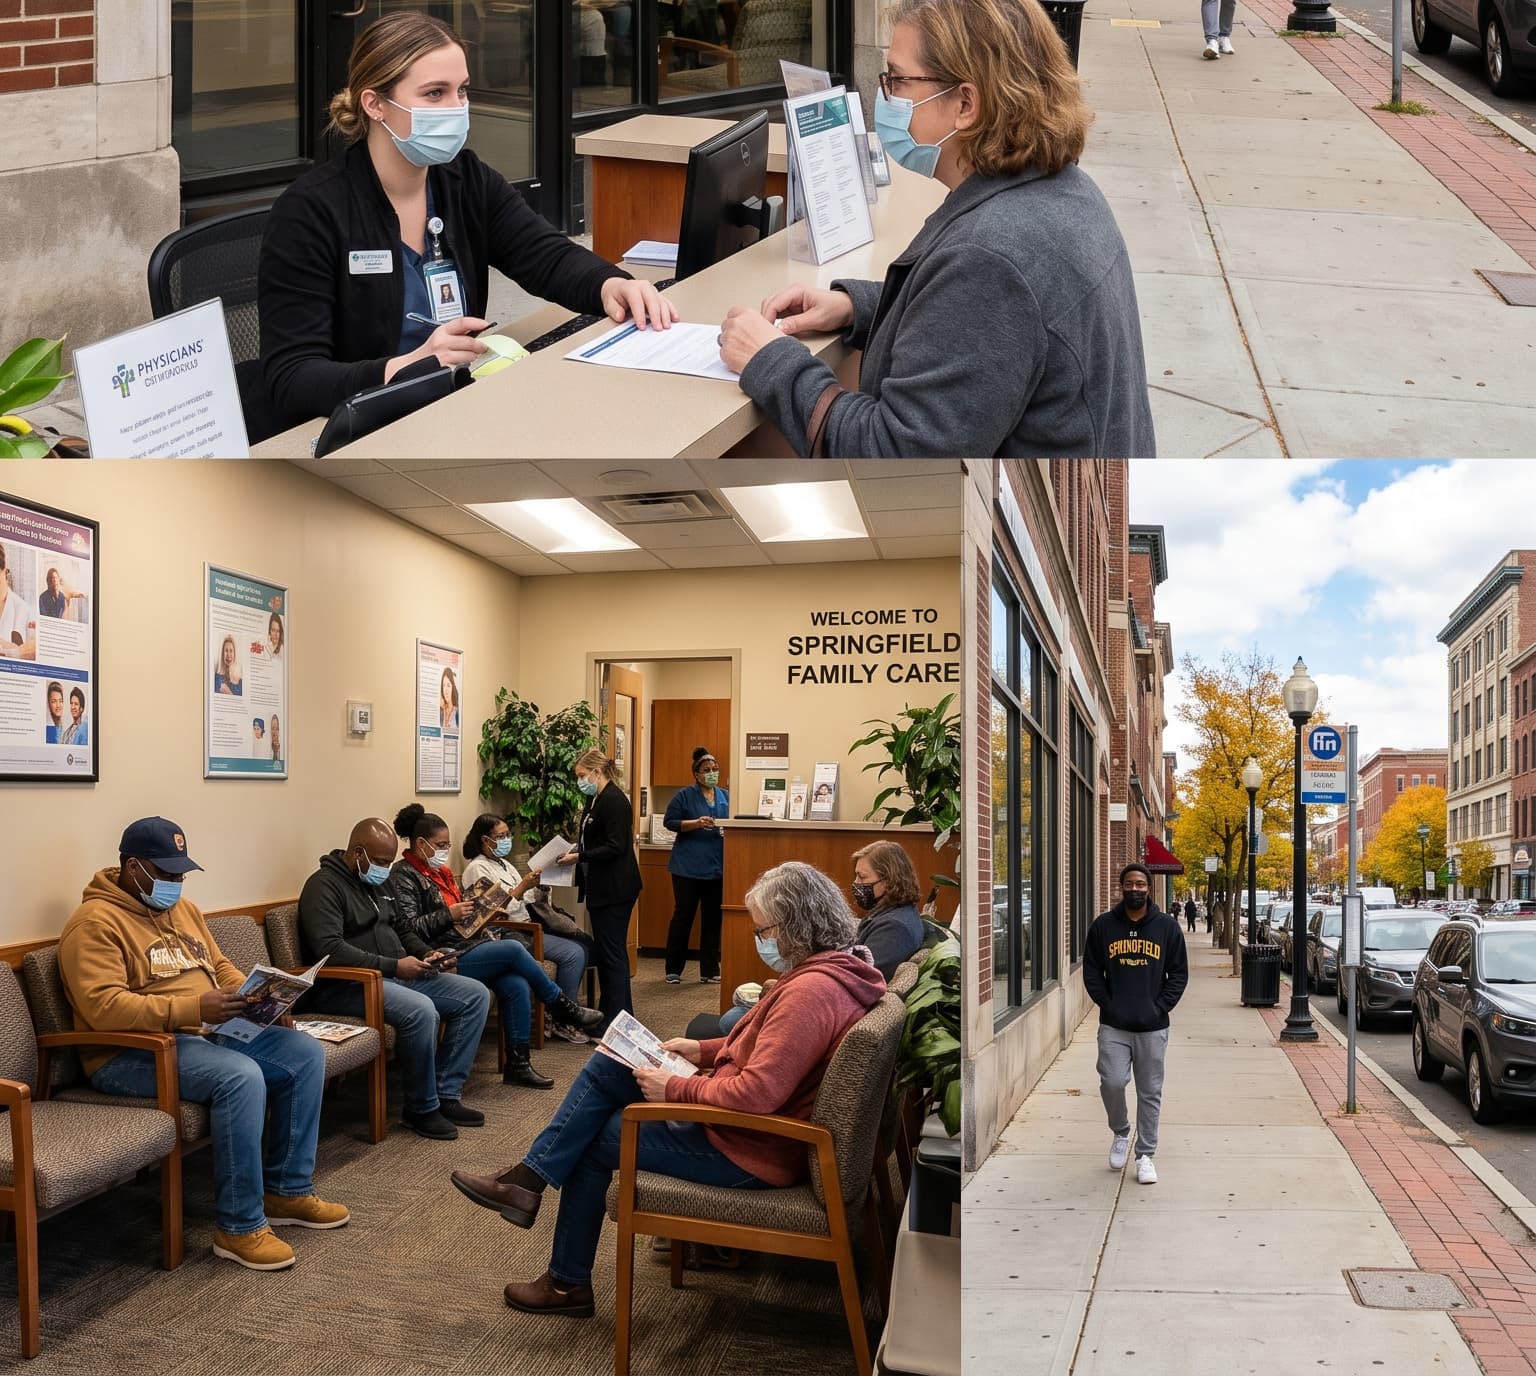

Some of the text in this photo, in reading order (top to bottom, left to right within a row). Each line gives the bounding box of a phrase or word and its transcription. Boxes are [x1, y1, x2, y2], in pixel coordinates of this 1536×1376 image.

[810, 608, 938, 626] WELCOME TO
[787, 632, 960, 656] SPRINGFIELD
[787, 662, 960, 685] FAMILY CARE
